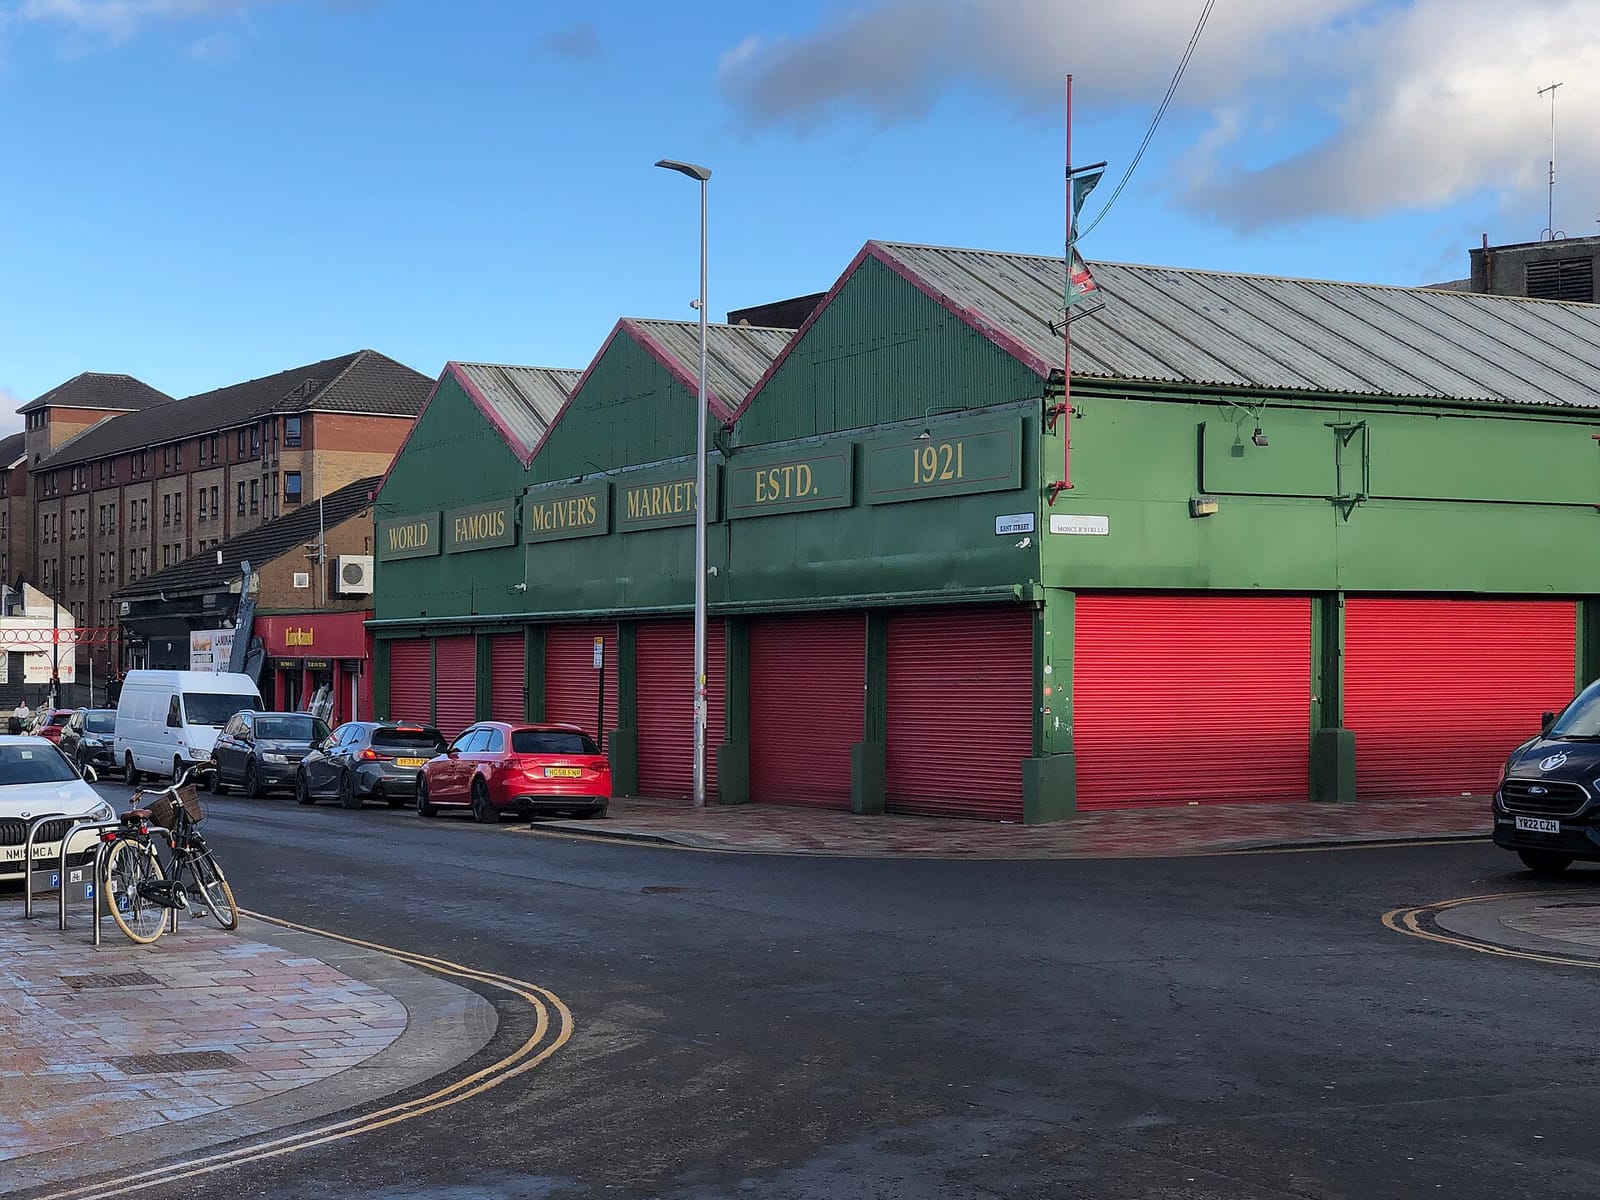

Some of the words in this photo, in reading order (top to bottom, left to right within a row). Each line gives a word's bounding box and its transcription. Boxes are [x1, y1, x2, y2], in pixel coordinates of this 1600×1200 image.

[388, 523, 429, 551] WORLD
[455, 510, 505, 543] FAMOUS
[532, 496, 596, 532] McIVER'S
[755, 464, 818, 503] ESTD.
[912, 441, 964, 484] 1921
[1013, 523, 1030, 531] STREET
[1518, 817, 1538, 829] YR22
[1539, 820, 1557, 831] CZH
[33, 846, 53, 857] MCA
